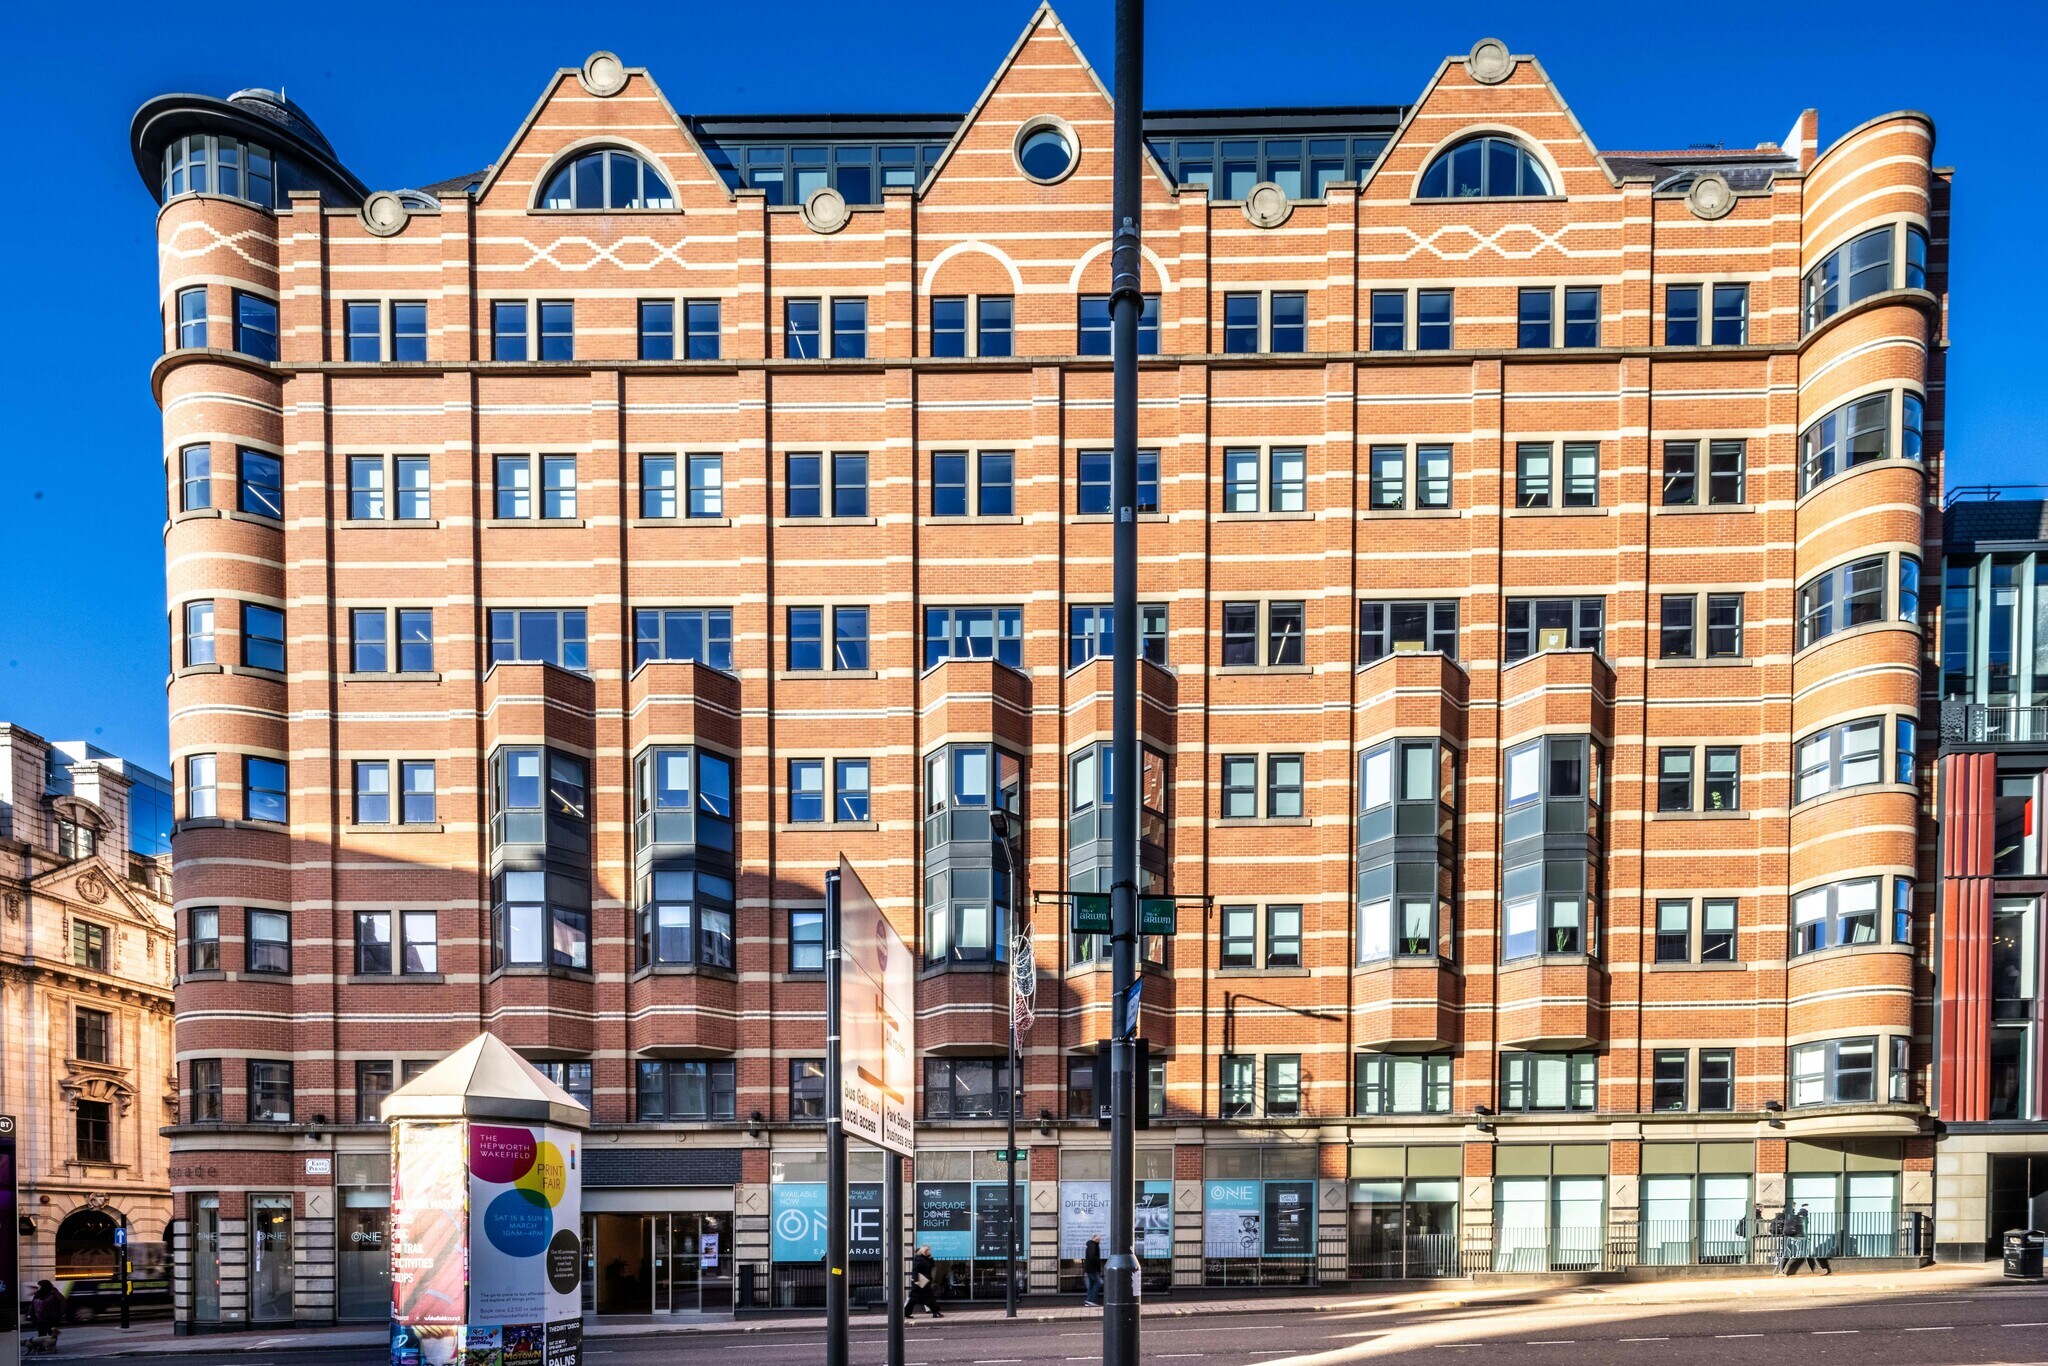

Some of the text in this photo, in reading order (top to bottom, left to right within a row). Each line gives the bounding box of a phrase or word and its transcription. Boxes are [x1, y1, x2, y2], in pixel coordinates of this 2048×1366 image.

[893, 1038, 905, 1058] routes
[844, 1081, 880, 1114] Bus Gate and
[844, 1104, 876, 1133] local access
[886, 1106, 911, 1132] Park Square
[886, 1125, 912, 1150] business area
[480, 1142, 530, 1151] HEPWORTH
[480, 1150, 530, 1159] WAKEFIELD
[538, 1164, 564, 1176] PRINT
[543, 1178, 560, 1189] FAIR
[1211, 1186, 1253, 1200] ONE
[924, 1202, 966, 1210] UPGRADE
[924, 1210, 950, 1218] DONE
[351, 1231, 382, 1242] ONE
